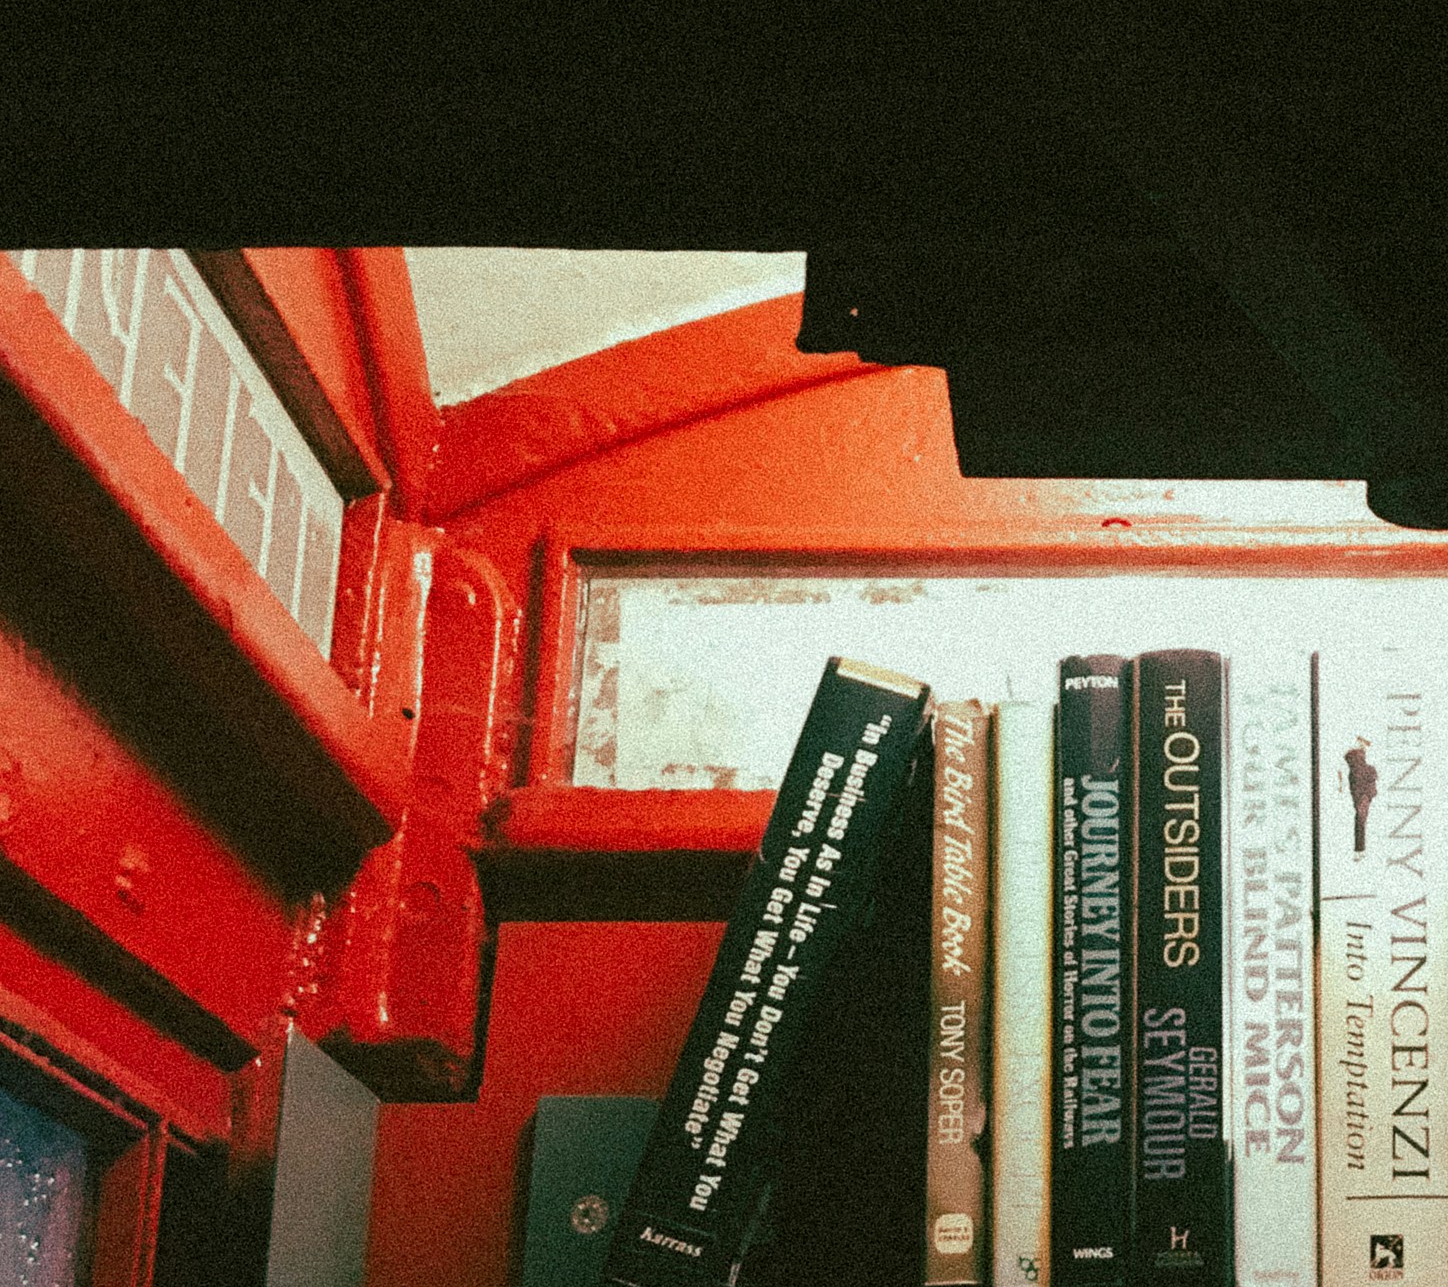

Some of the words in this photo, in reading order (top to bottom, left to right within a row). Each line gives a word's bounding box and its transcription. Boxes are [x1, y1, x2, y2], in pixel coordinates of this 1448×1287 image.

[1165, 679, 1188, 727] THE
[943, 716, 974, 766] The
[826, 746, 879, 841] Business
[943, 769, 974, 831] Bird
[1063, 778, 1080, 806] and
[1386, 691, 1427, 877] PENNY
[1063, 808, 1080, 847] other
[1080, 774, 1121, 936] JOURNEY
[1161, 731, 1201, 969] OUTSIDERS
[777, 838, 813, 882] You
[808, 871, 832, 893] In
[819, 842, 843, 870] As
[942, 835, 974, 902] Table
[1063, 850, 1080, 889] Great
[762, 886, 794, 927] Get
[793, 894, 823, 944] Life
[1063, 893, 1080, 947] Stories
[1242, 846, 1271, 1004] BLIND
[739, 928, 777, 984] What
[942, 906, 973, 975] Book
[1063, 950, 1080, 966] of
[1344, 918, 1375, 987] Into
[724, 984, 754, 1026] You
[764, 961, 800, 1001] You
[1063, 969, 1080, 1019] Horror
[1080, 945, 1121, 1036] INTO
[938, 1000, 967, 1062] TONY
[1063, 1023, 1080, 1043] on
[1272, 870, 1306, 1164] PATTERSON
[1388, 894, 1431, 1182] VINCENZI
[728, 1065, 759, 1108] Get
[1063, 1047, 1080, 1073] the
[1338, 992, 1378, 1172] Temptation
[938, 1067, 967, 1144] SOPER
[1062, 1076, 1080, 1149] Railways
[1080, 1044, 1121, 1149] FEAR
[1142, 1006, 1188, 1180] SEYMOUR
[1188, 1046, 1219, 1140] GERALD
[1242, 1020, 1272, 1159] MICE
[703, 1110, 746, 1166] What
[688, 1167, 722, 1212] You
